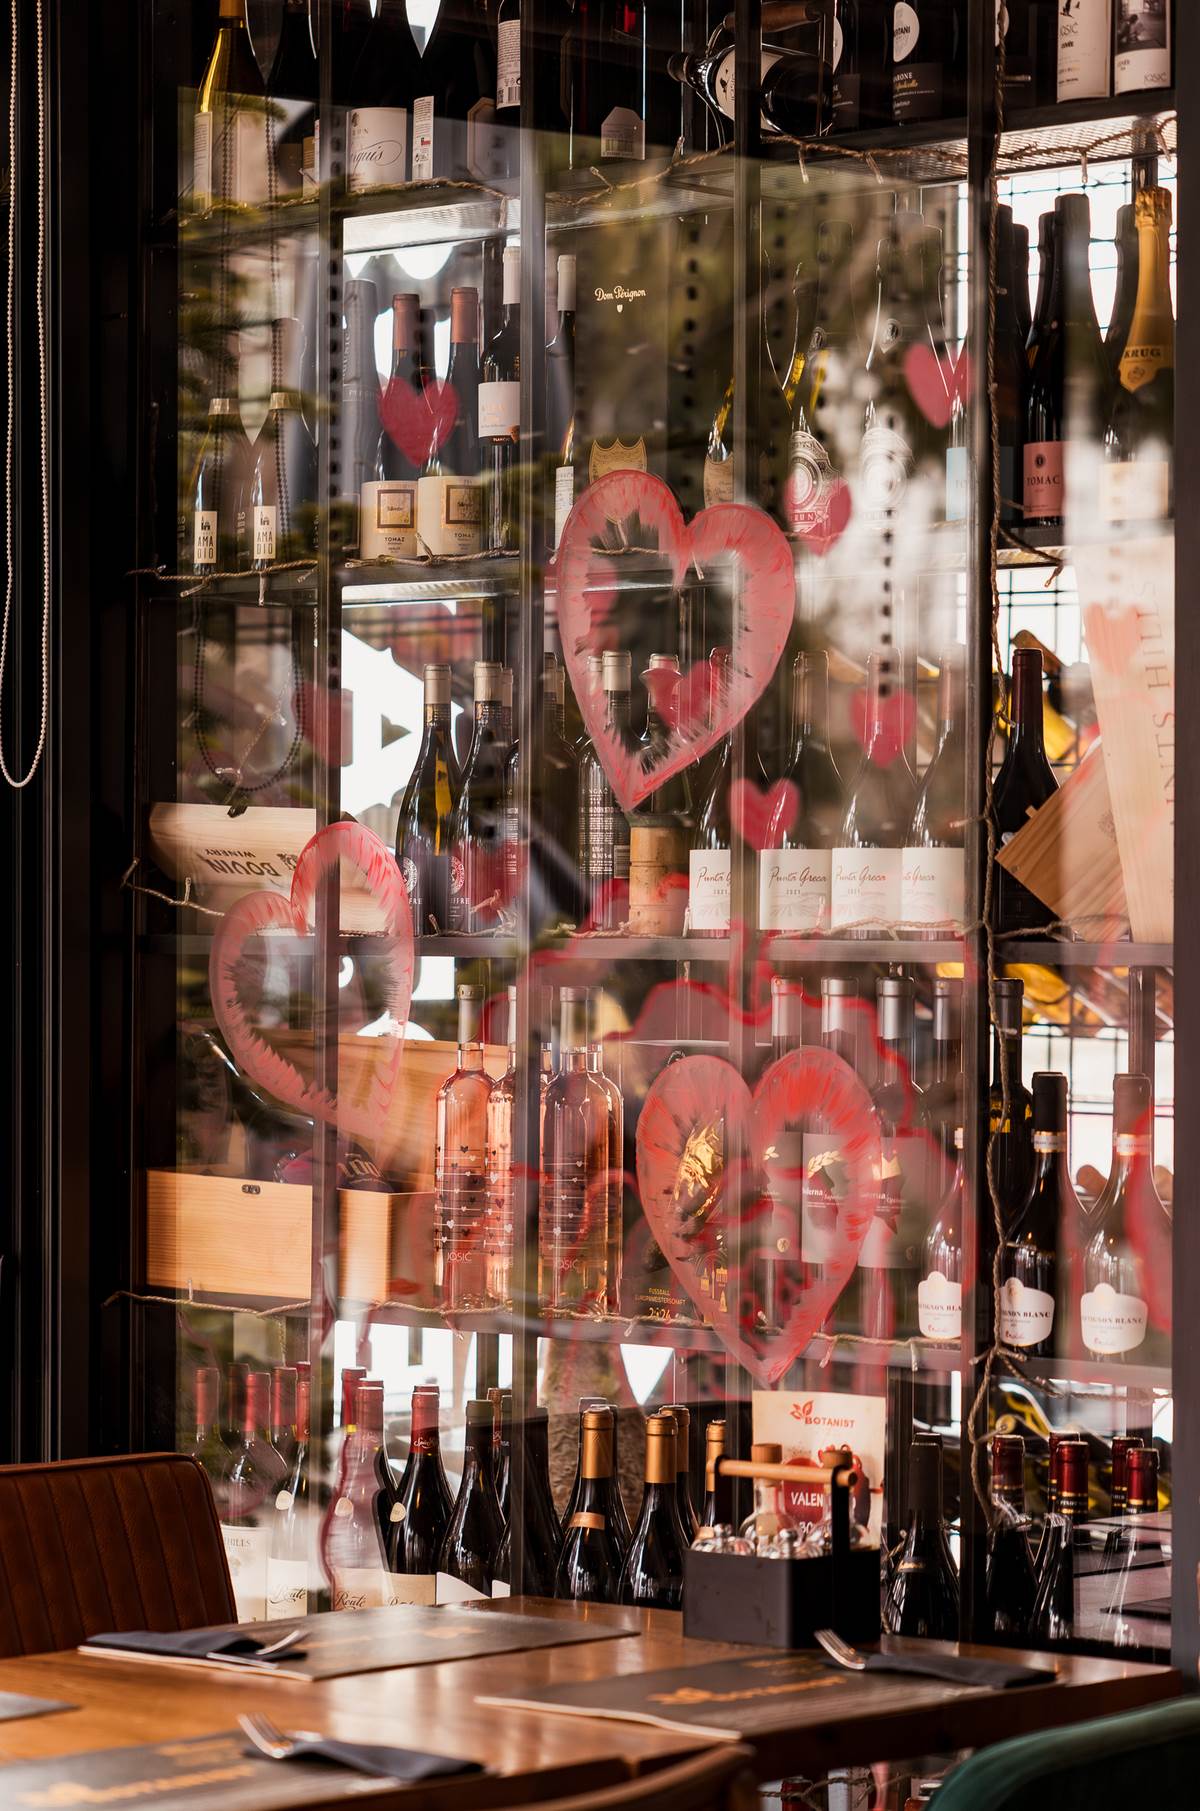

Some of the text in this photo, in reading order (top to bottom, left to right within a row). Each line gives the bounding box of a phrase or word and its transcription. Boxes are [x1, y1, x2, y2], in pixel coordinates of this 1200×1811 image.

[594, 285, 646, 302] Dom Pérignon
[1124, 349, 1161, 358] KRUG
[1027, 475, 1060, 485] TOMAC
[805, 1417, 855, 1428] BOTANIST
[791, 1491, 824, 1507] VALEN
